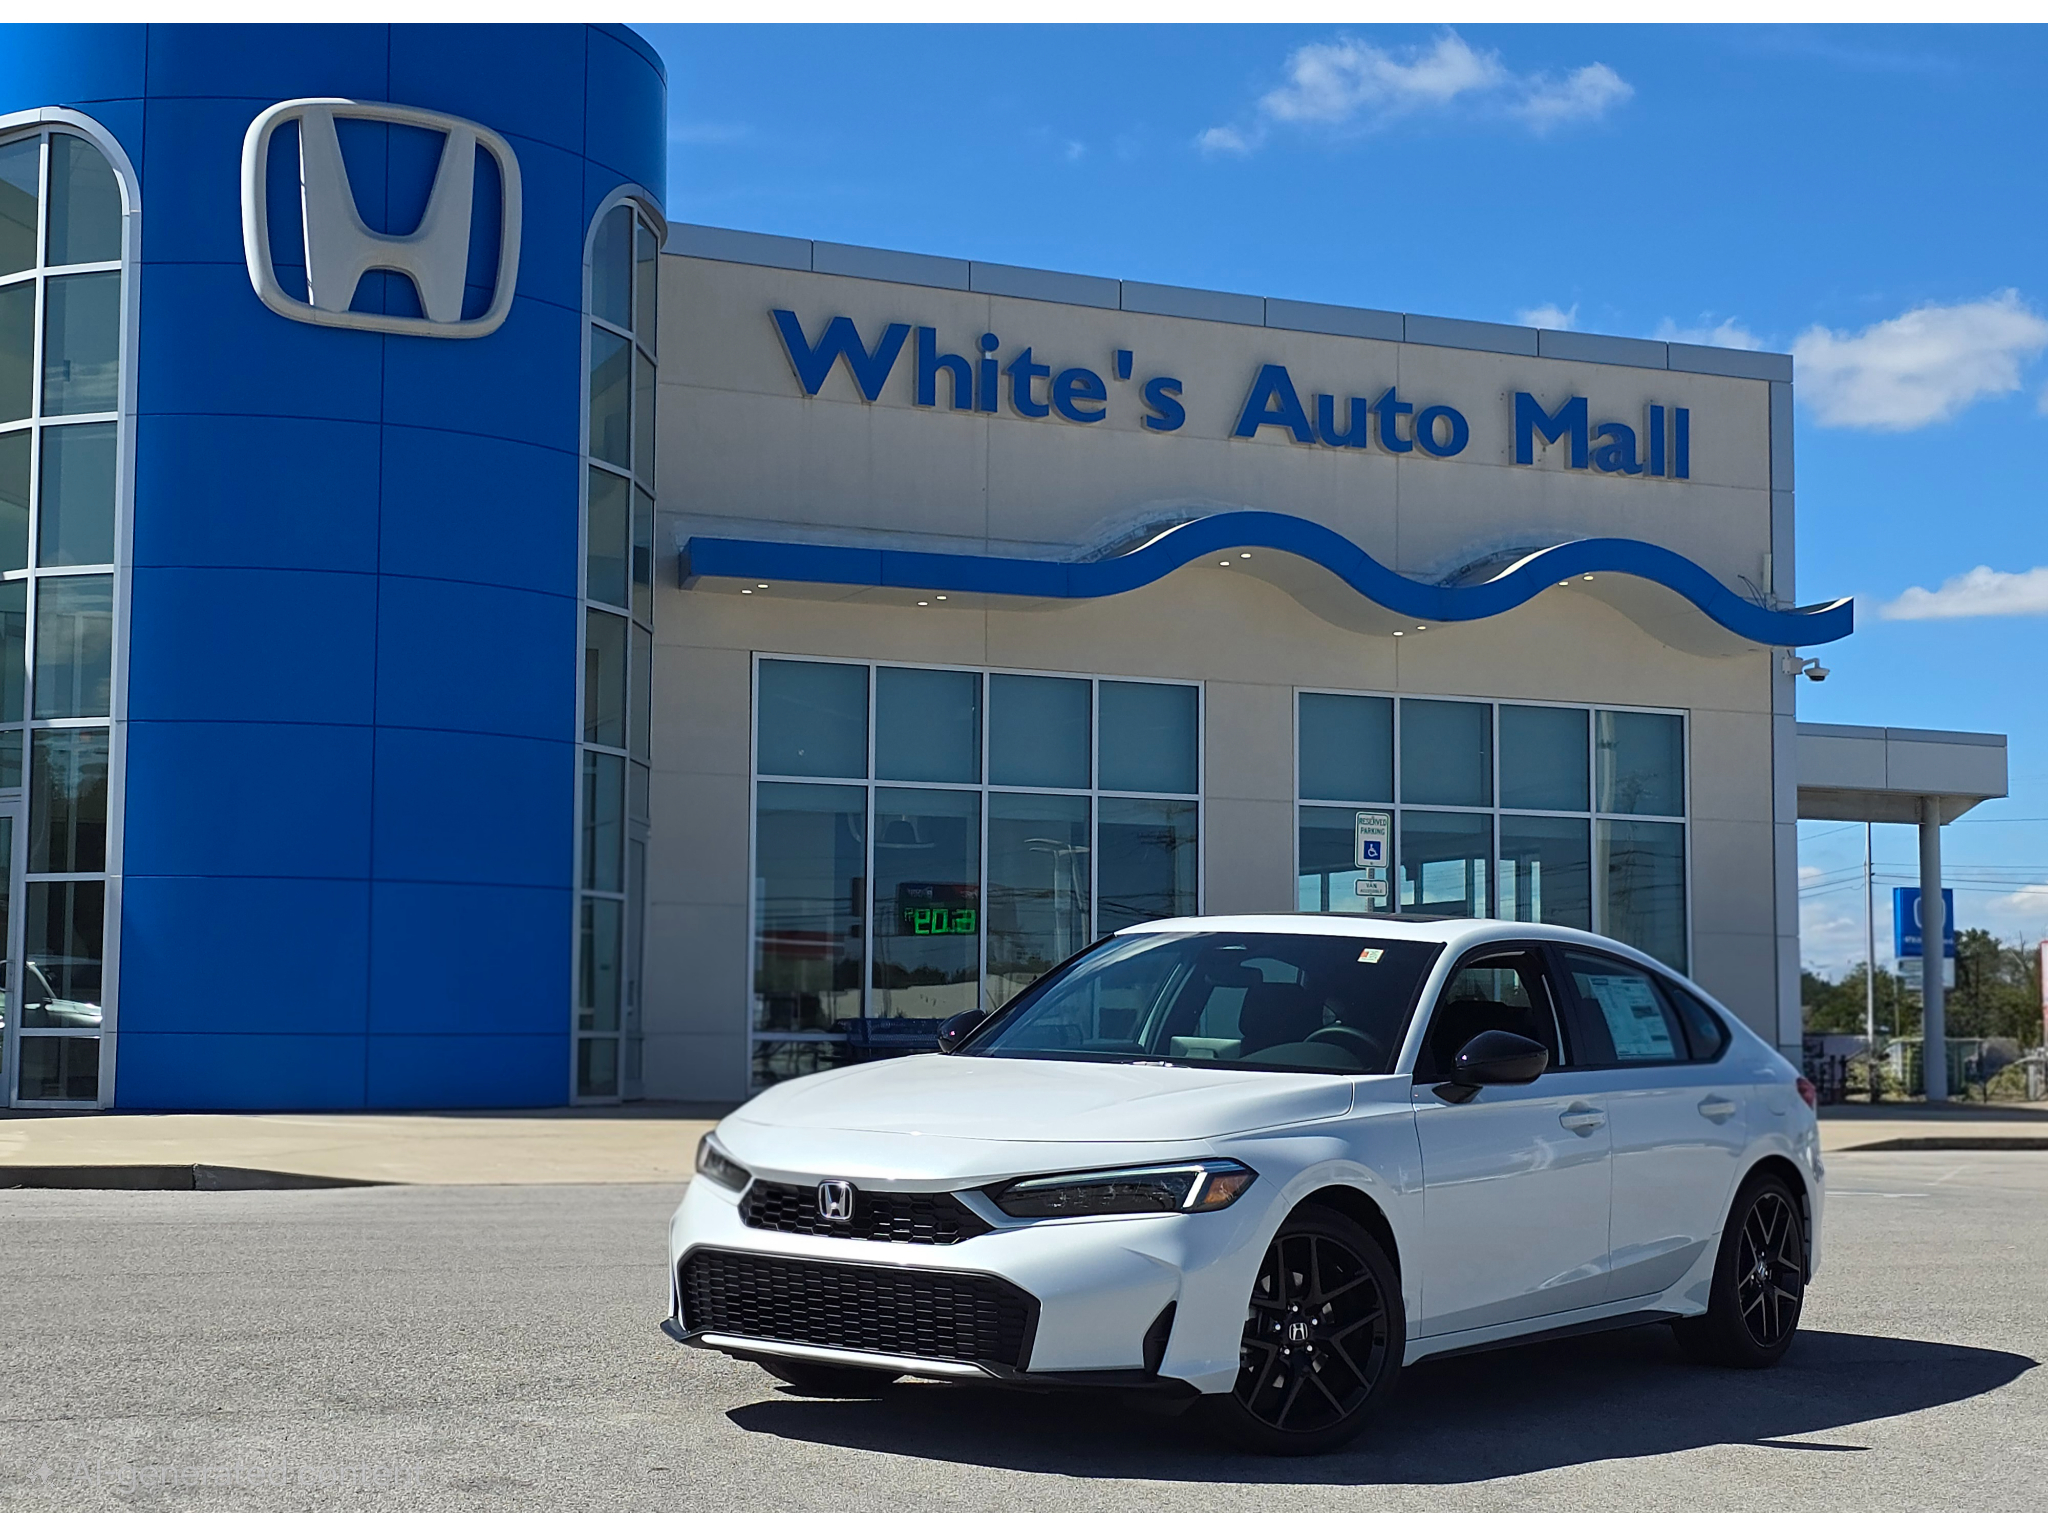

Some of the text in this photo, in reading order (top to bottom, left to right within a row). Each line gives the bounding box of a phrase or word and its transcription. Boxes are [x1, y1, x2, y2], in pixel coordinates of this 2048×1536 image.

[768, 309, 1690, 480] White's Auto Mall
[1358, 817, 1387, 827] RESERVED
[1360, 827, 1386, 836] PARKING
